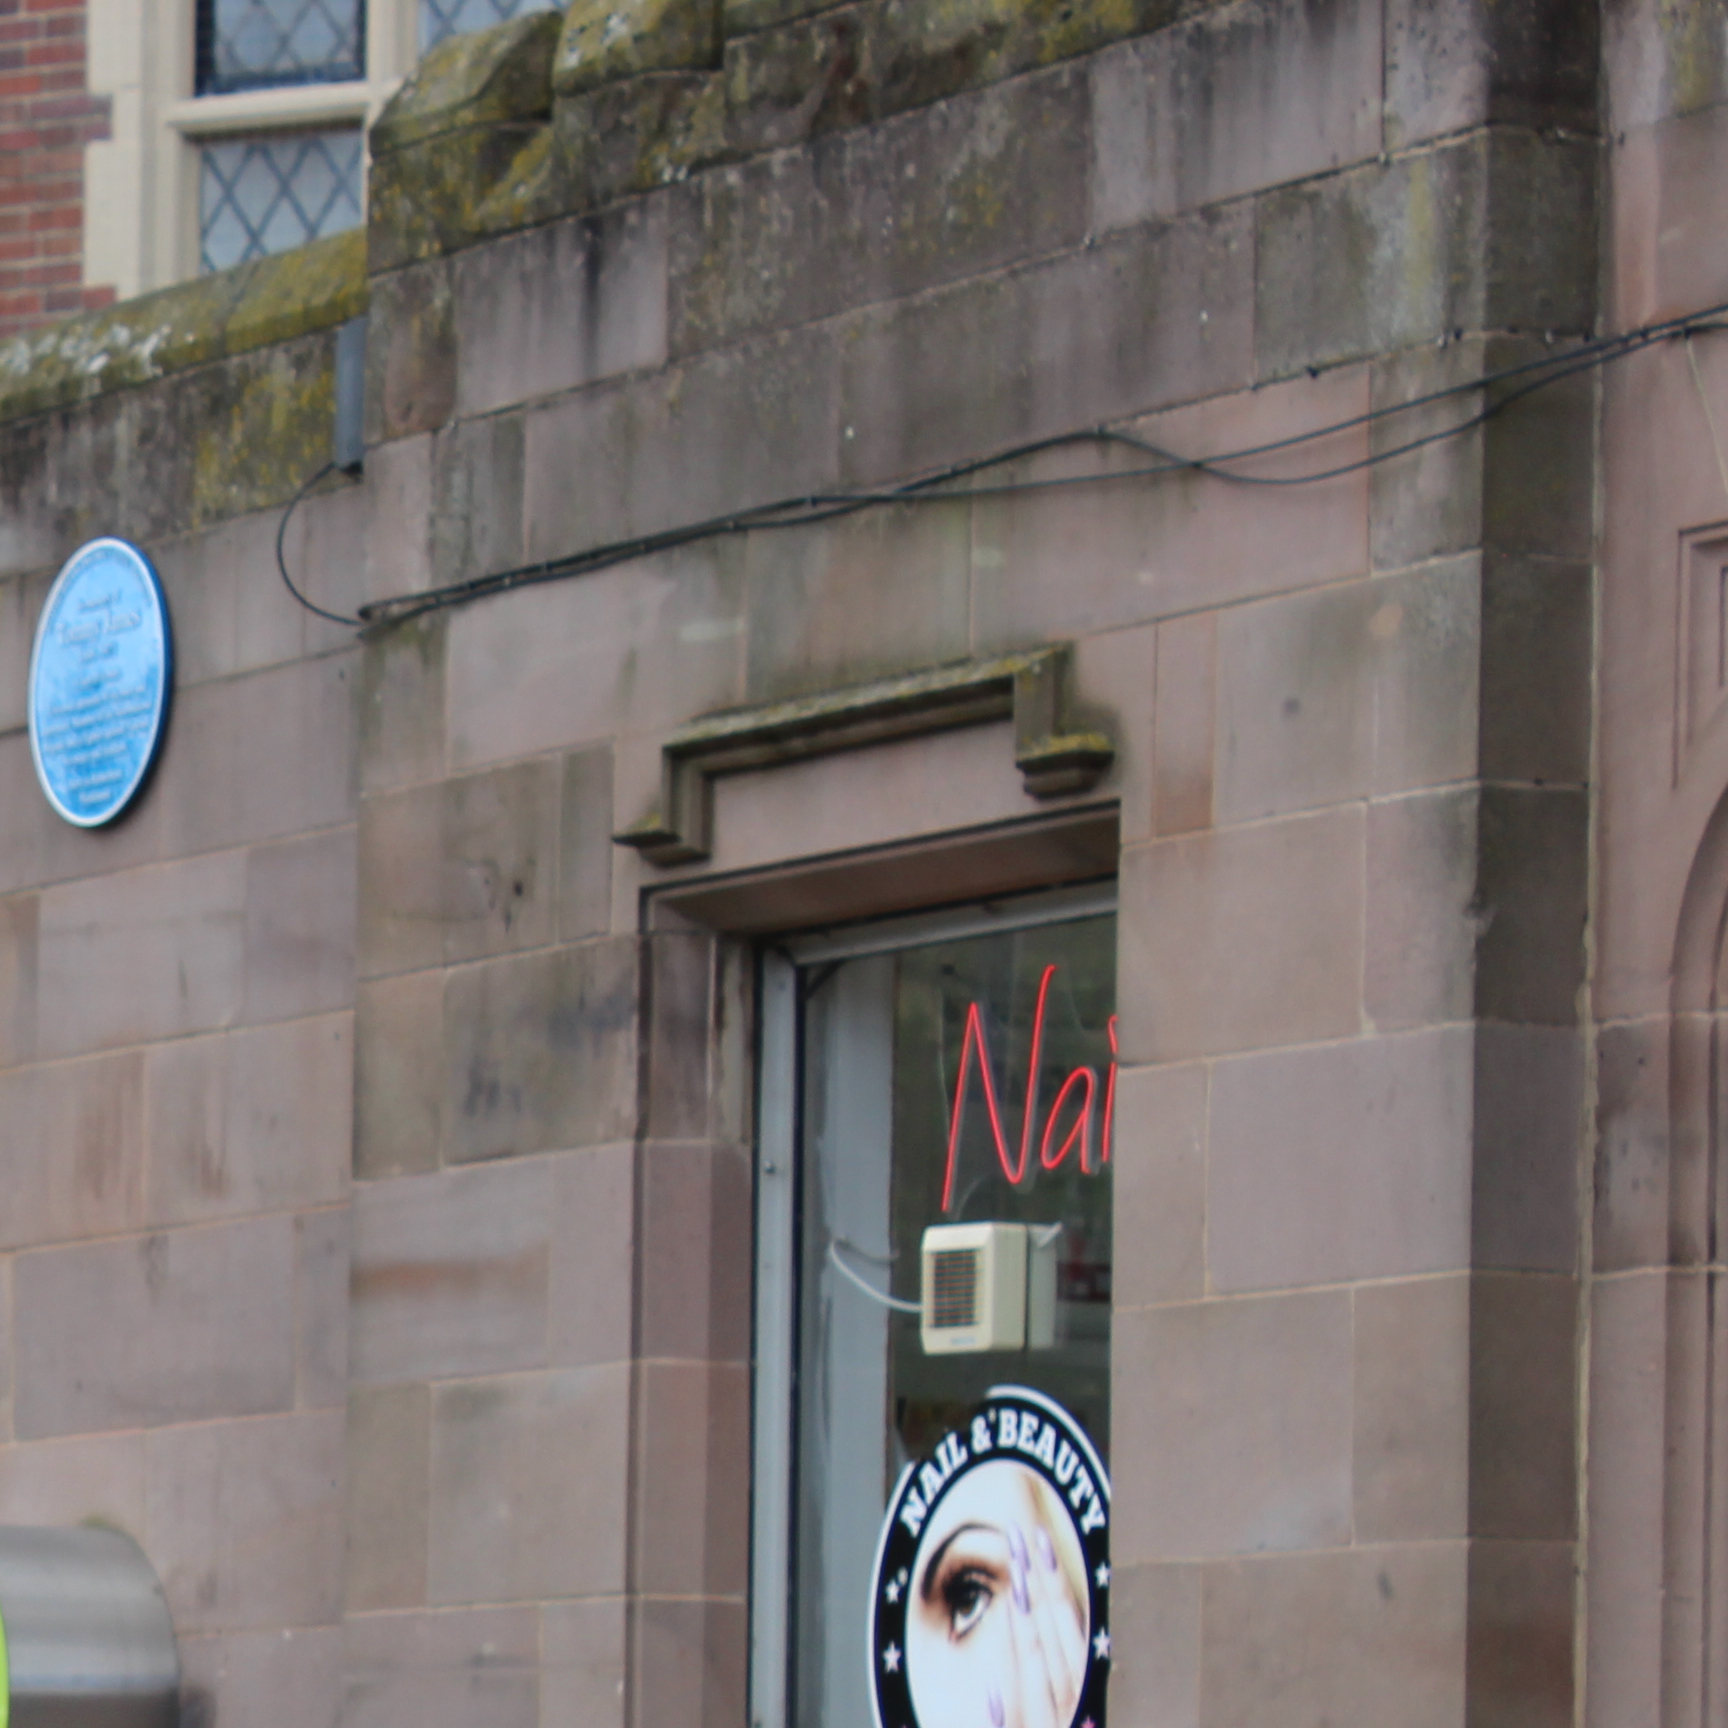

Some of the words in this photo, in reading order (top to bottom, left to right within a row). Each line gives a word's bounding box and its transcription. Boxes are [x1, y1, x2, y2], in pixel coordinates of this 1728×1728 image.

[900, 1431, 969, 1538] NAIL
[971, 1415, 993, 1454] &
[997, 1407, 1107, 1535] BEAUTY
